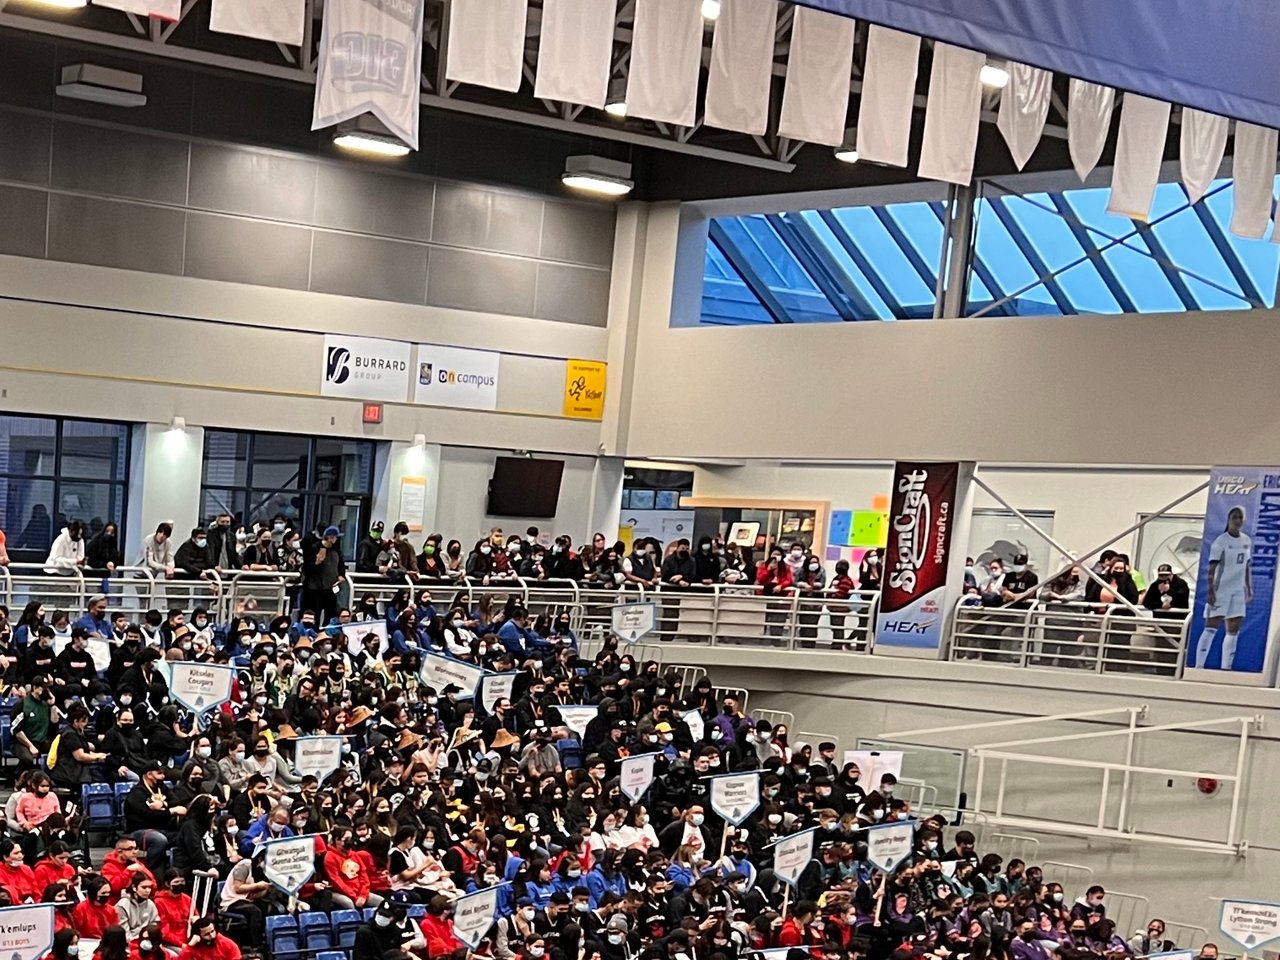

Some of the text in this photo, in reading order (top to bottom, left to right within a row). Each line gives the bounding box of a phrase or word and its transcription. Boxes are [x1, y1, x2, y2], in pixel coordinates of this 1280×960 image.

[354, 356, 407, 372] BURRARD
[354, 371, 382, 381] GROUP
[457, 374, 495, 389] campus
[1214, 483, 1259, 495] HEAT
[888, 468, 929, 595] SignCraft
[934, 501, 950, 565] signcraft.ca
[883, 619, 938, 635] HEAT
[187, 677, 214, 688] Cougars
[14, 937, 30, 946] BOYS
